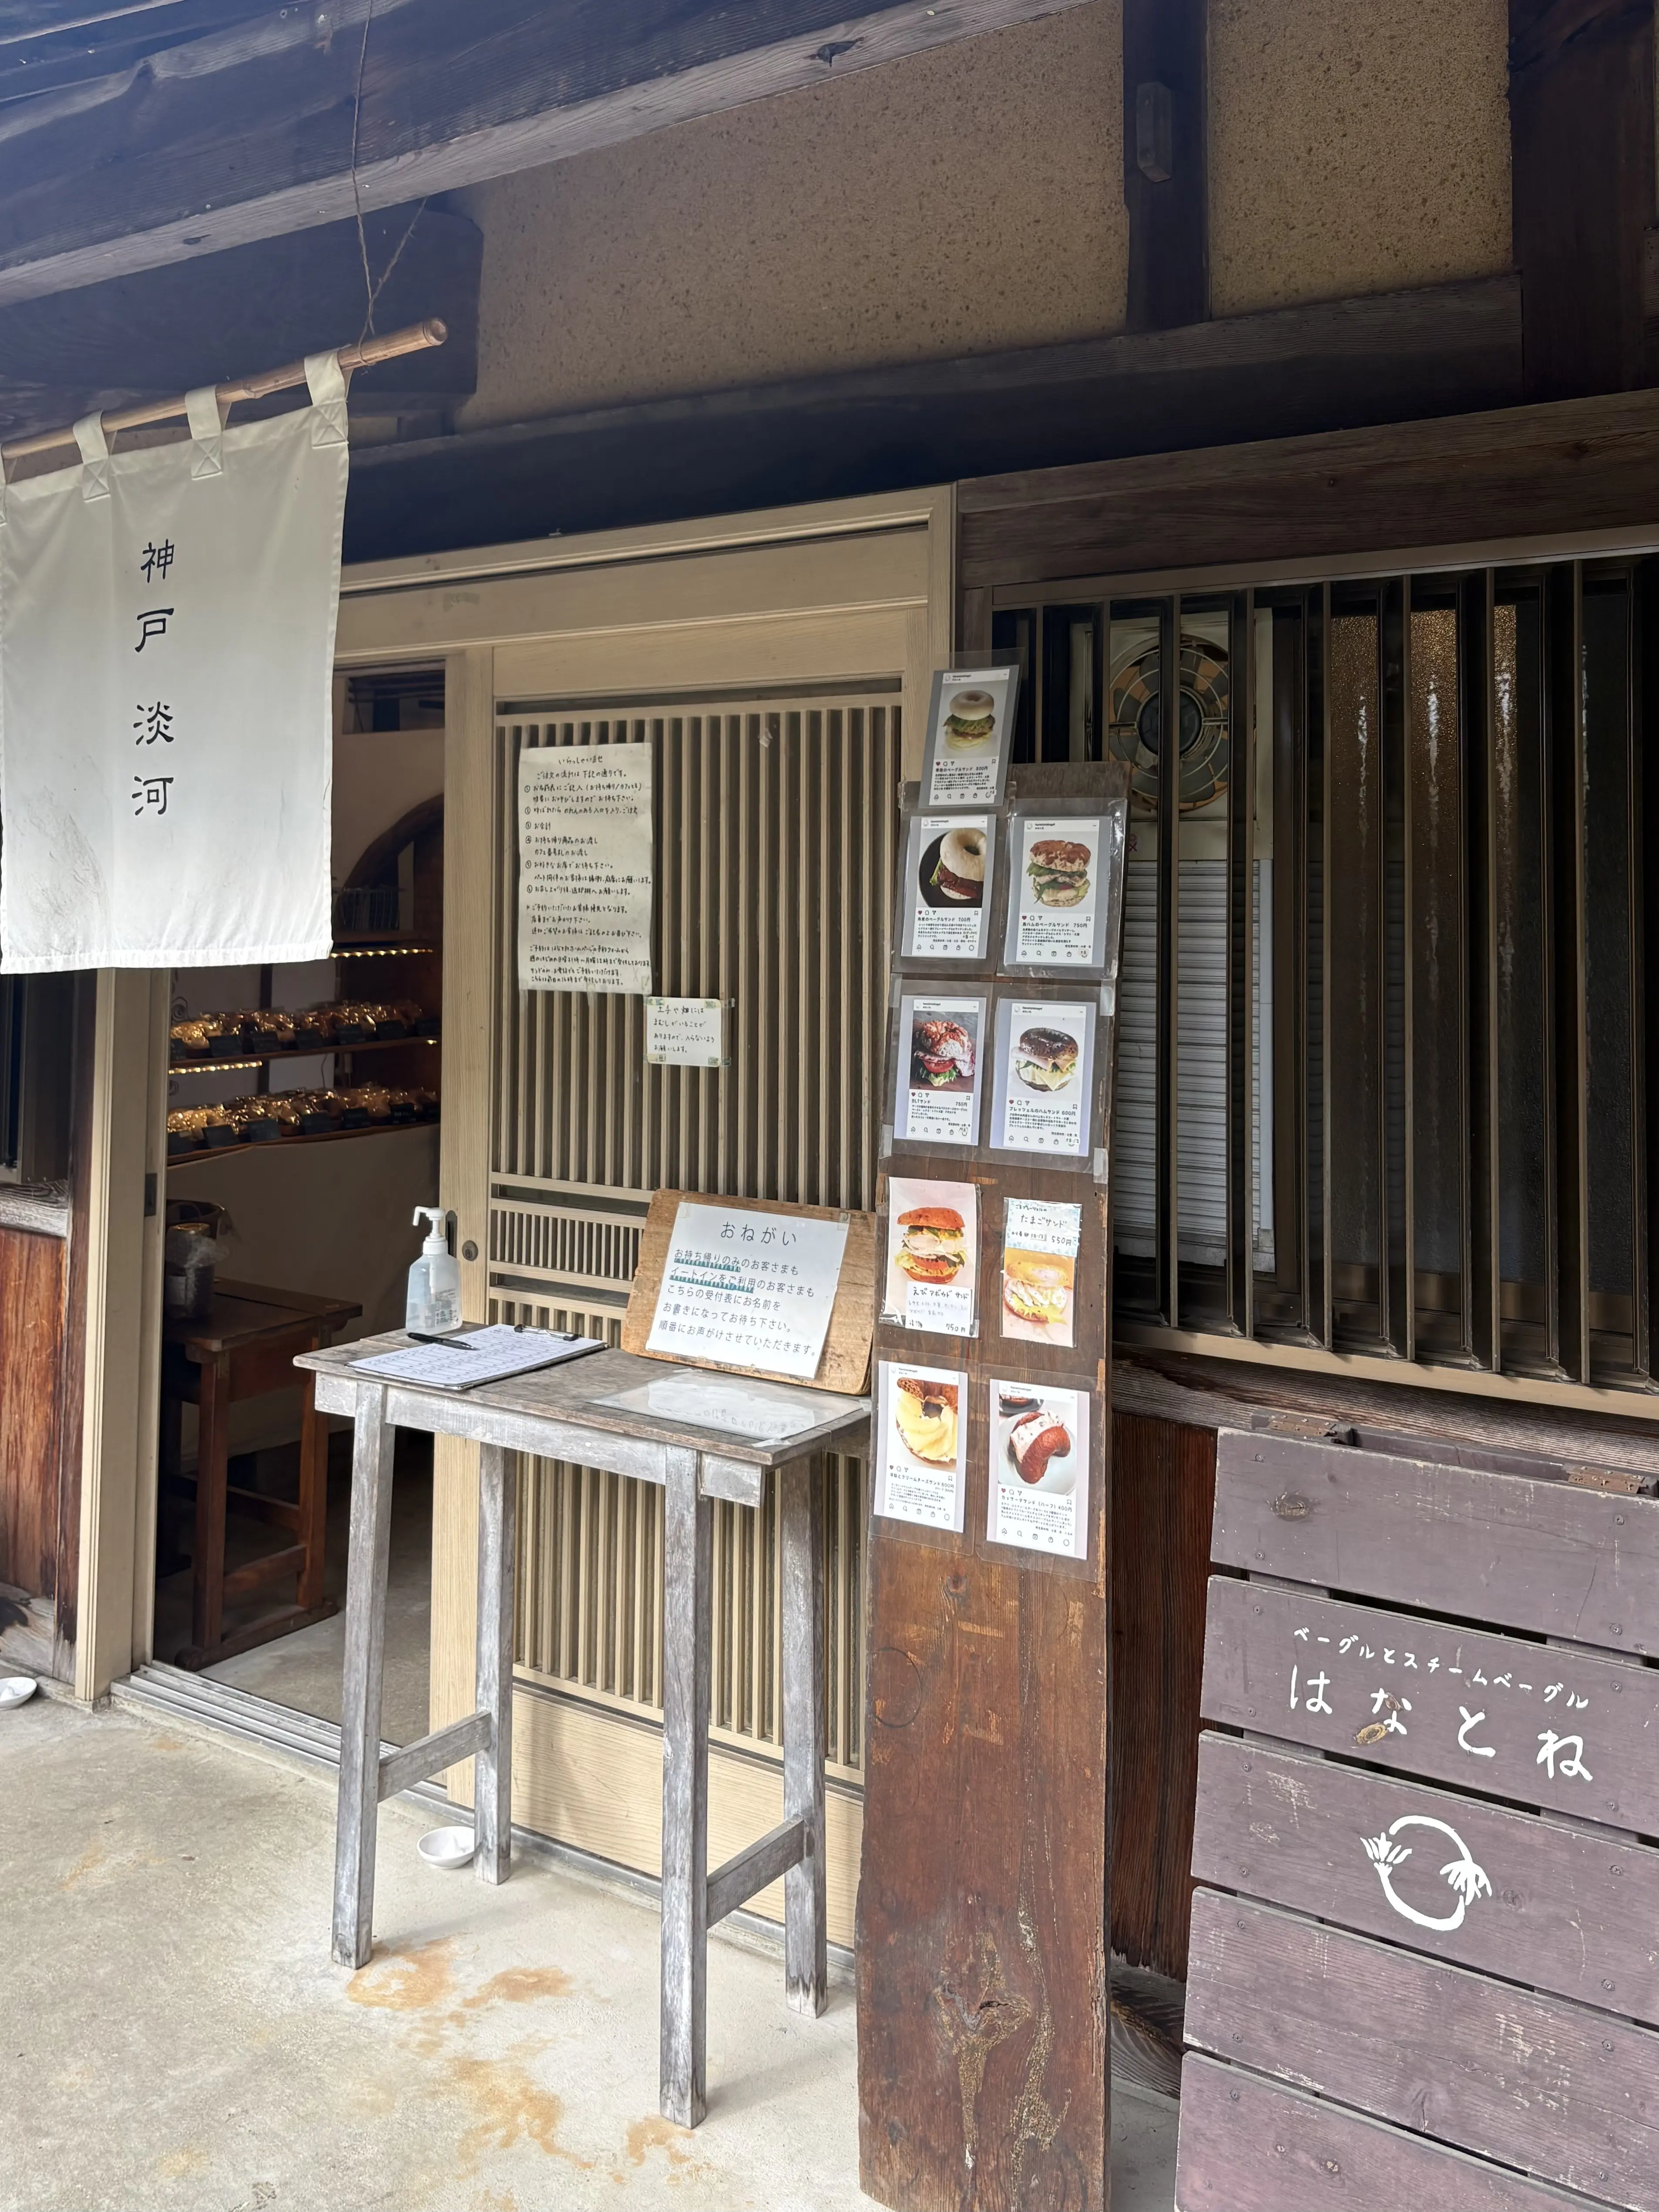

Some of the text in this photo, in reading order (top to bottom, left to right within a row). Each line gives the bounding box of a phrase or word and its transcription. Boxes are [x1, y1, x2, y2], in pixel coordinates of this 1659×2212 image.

[131, 538, 175, 816] 神戸淡河
[558, 755, 603, 765] いらっしゃいませ
[658, 1004, 704, 1014] 土手や畑には
[654, 1018, 706, 1027] まむしがいることが
[654, 1045, 687, 1053] お願いします。
[720, 1221, 796, 1246] おねがい
[1021, 1214, 1067, 1229] たまごサンド
[1051, 1235, 1072, 1246] 550円
[674, 1249, 799, 1276] お持ち帰りのみのお客さまも
[670, 1267, 814, 1297] イートインをご利用のお客さまも
[668, 1284, 781, 1311] こちらの受付表にお名前を
[662, 1302, 791, 1333] お書きになってお待ち下さい。
[946, 1323, 966, 1333] 750円
[658, 1320, 816, 1356] 順番にお声がけさせていただきます。
[1294, 1627, 1590, 1709] ベーグルとスチームベーグル
[1290, 1666, 1593, 1782] はなとね
